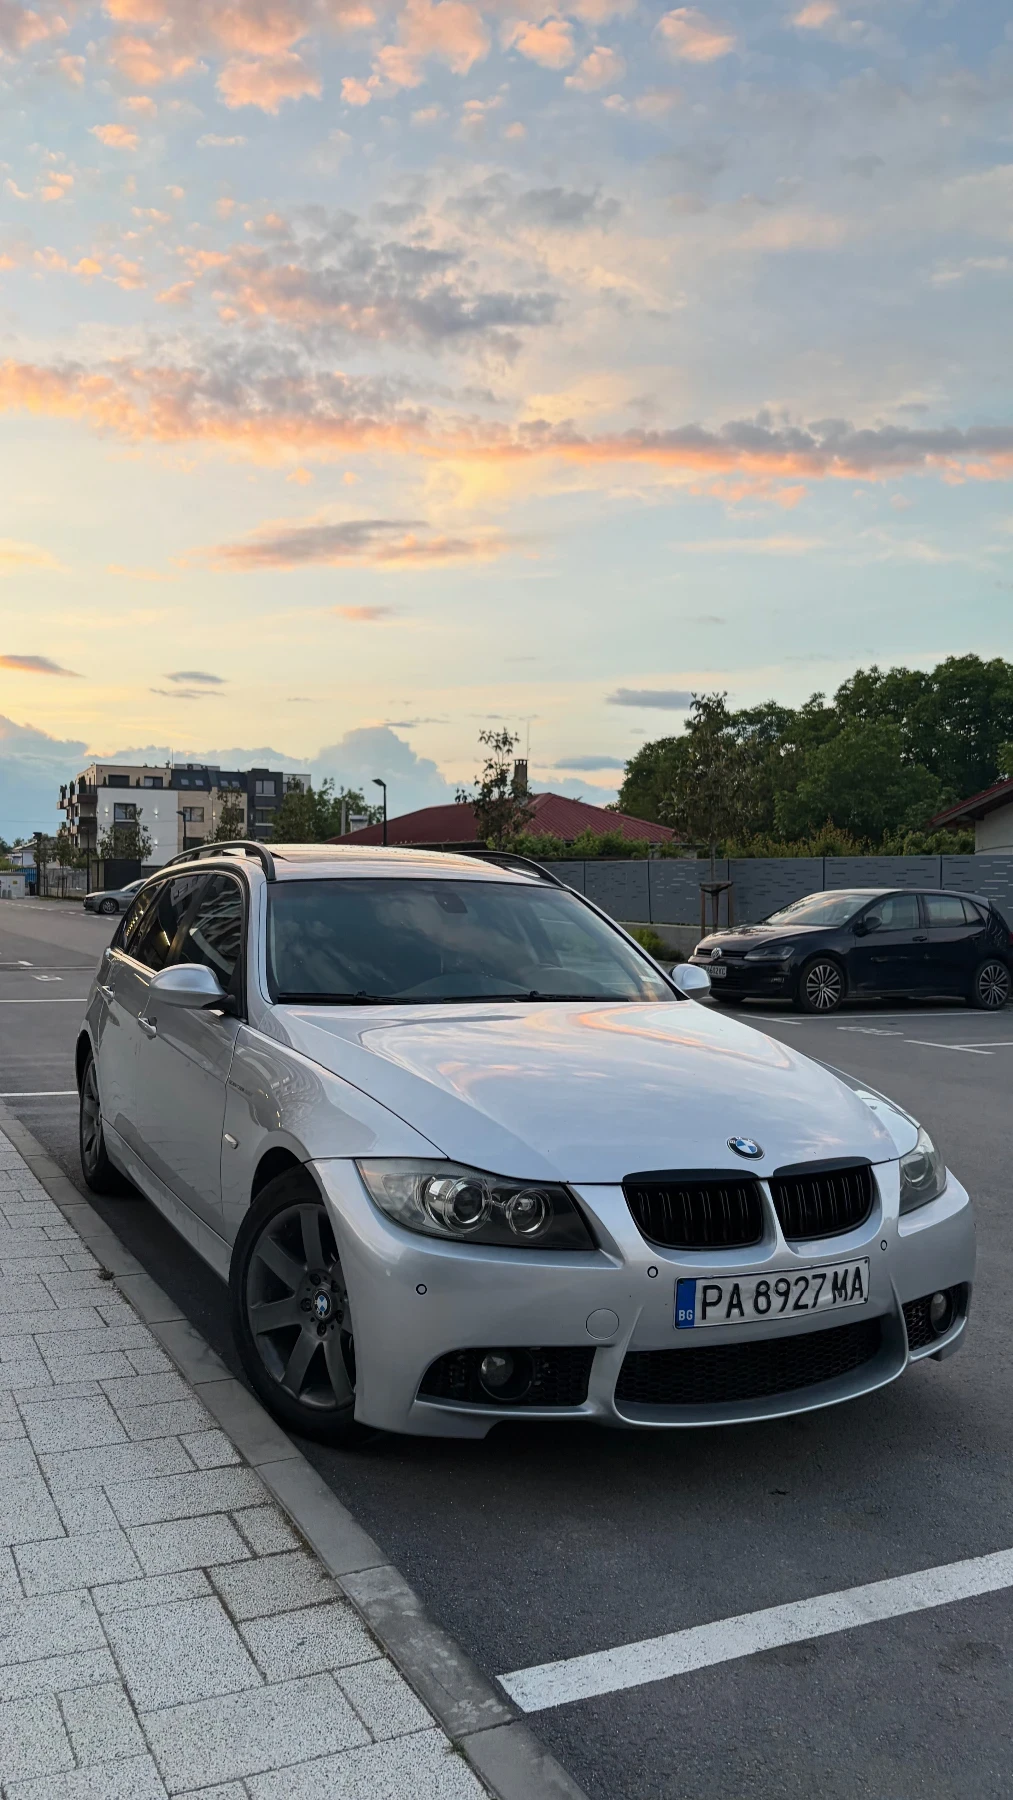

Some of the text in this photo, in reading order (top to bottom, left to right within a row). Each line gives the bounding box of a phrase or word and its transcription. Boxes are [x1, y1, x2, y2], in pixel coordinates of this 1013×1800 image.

[701, 1266, 864, 1320] PA 8927 MA
[678, 1309, 693, 1321] BG
